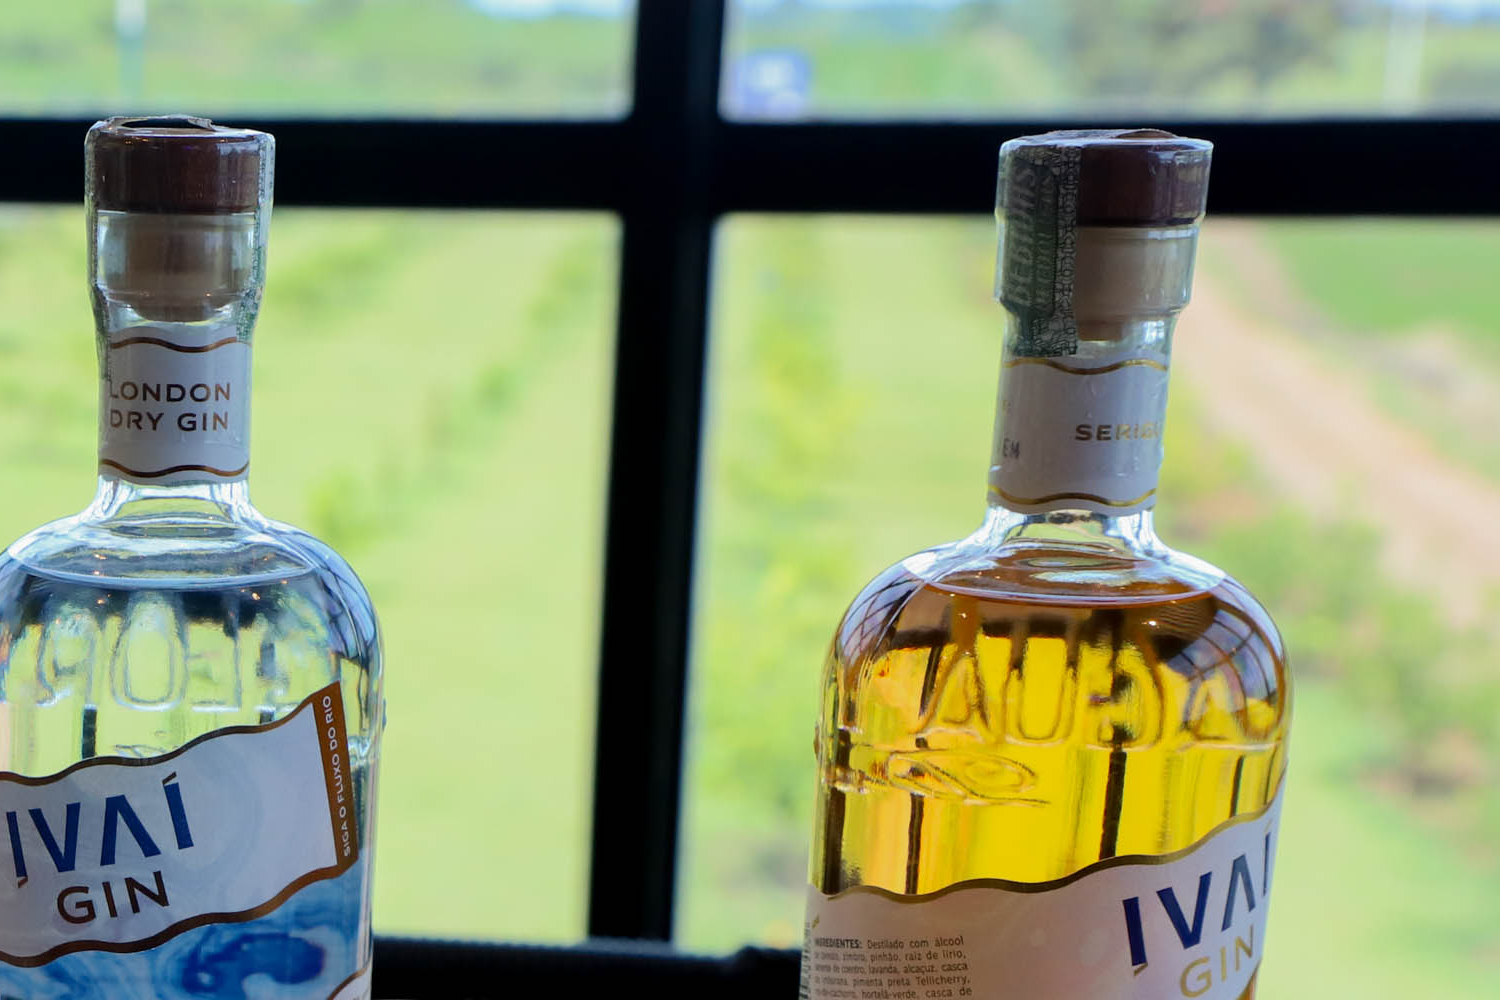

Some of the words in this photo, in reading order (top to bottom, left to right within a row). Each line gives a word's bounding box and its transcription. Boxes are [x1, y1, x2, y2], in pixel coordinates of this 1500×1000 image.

[109, 382, 231, 403] LONDON
[109, 409, 164, 431] DRY
[177, 411, 229, 432] GIN
[322, 695, 334, 724] RIO
[327, 727, 339, 750] DO
[332, 753, 345, 804] FLUXO
[339, 806, 347, 818] O
[340, 821, 350, 857] SIGA
[56, 870, 170, 925] GIN
[909, 940, 929, 949] com
[935, 935, 964, 947] álcool
[905, 951, 922, 961] raiz
[926, 950, 938, 960] de
[1180, 924, 1254, 998] GIN
[941, 962, 968, 973] casca
[887, 976, 911, 987] preta
[915, 975, 971, 986] Tellicherry,
[925, 988, 953, 997] casca
[959, 986, 972, 996] de
